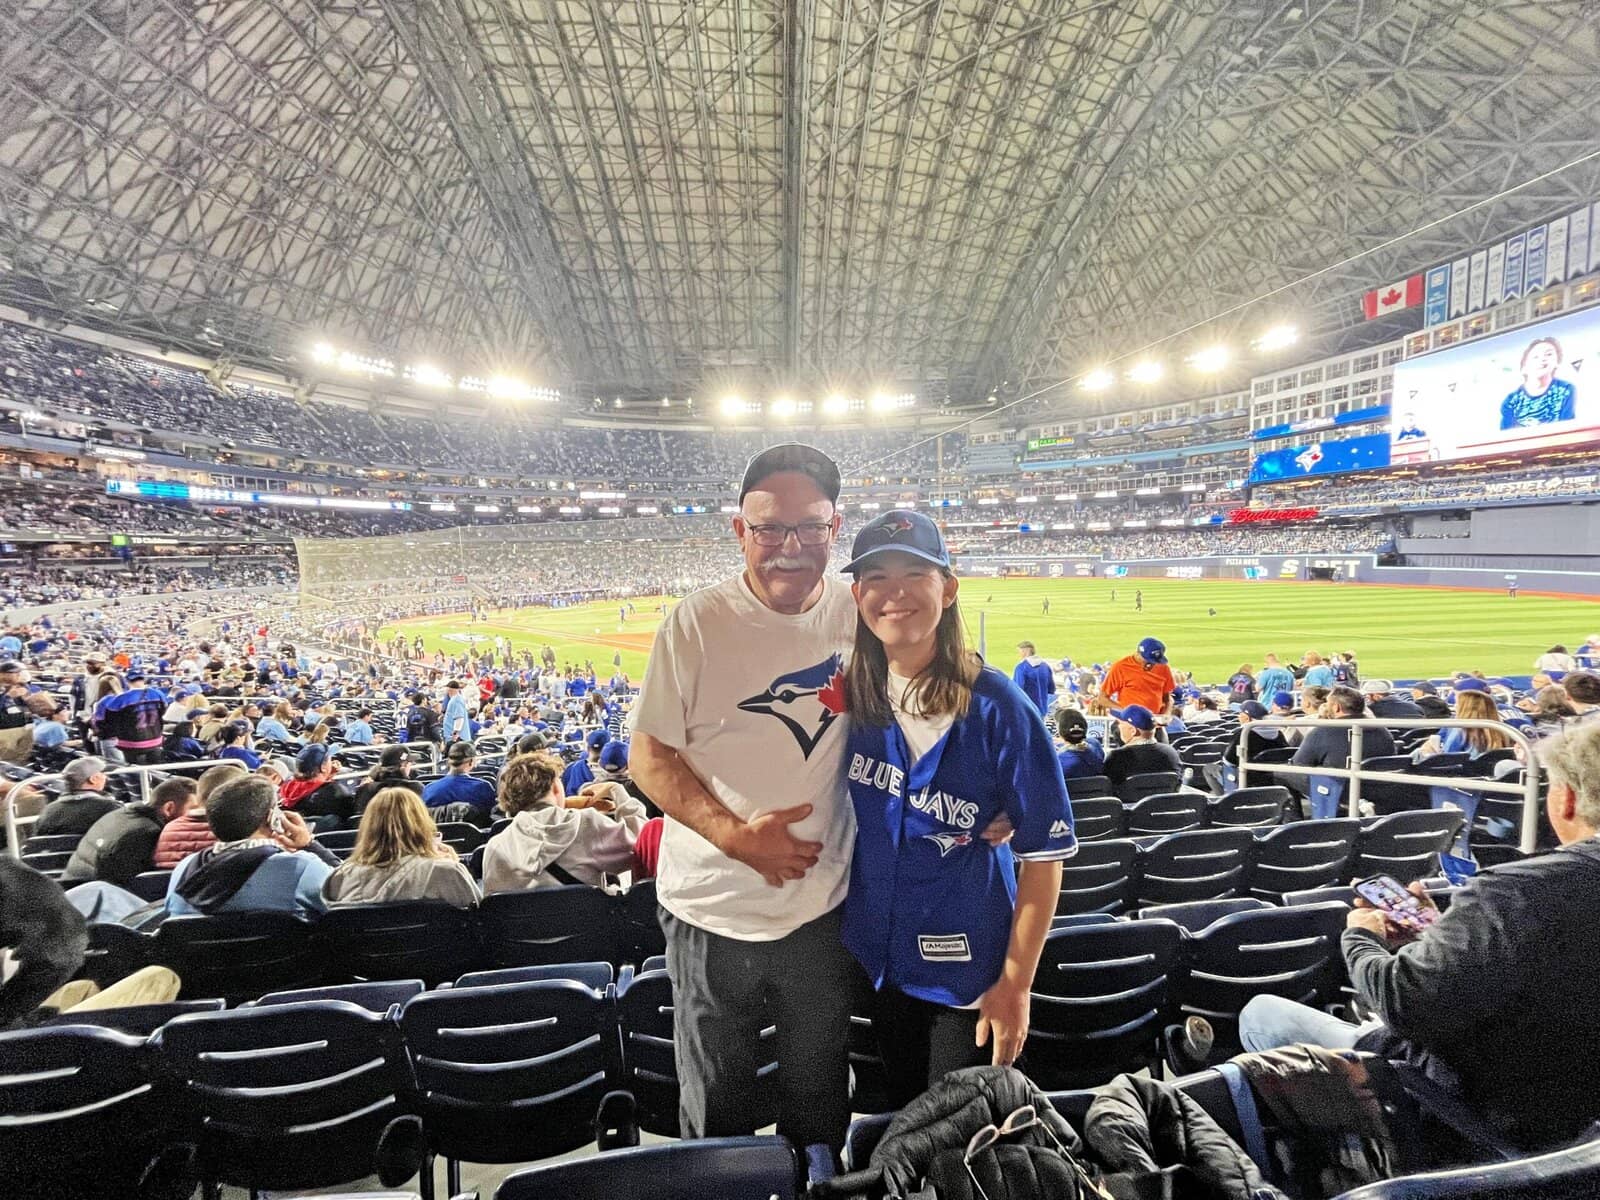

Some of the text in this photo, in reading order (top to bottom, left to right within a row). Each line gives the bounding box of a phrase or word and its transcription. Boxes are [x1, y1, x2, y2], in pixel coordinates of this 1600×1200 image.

[1230, 507, 1319, 526] Budweiser
[848, 753, 980, 829] BLUE JAYS
